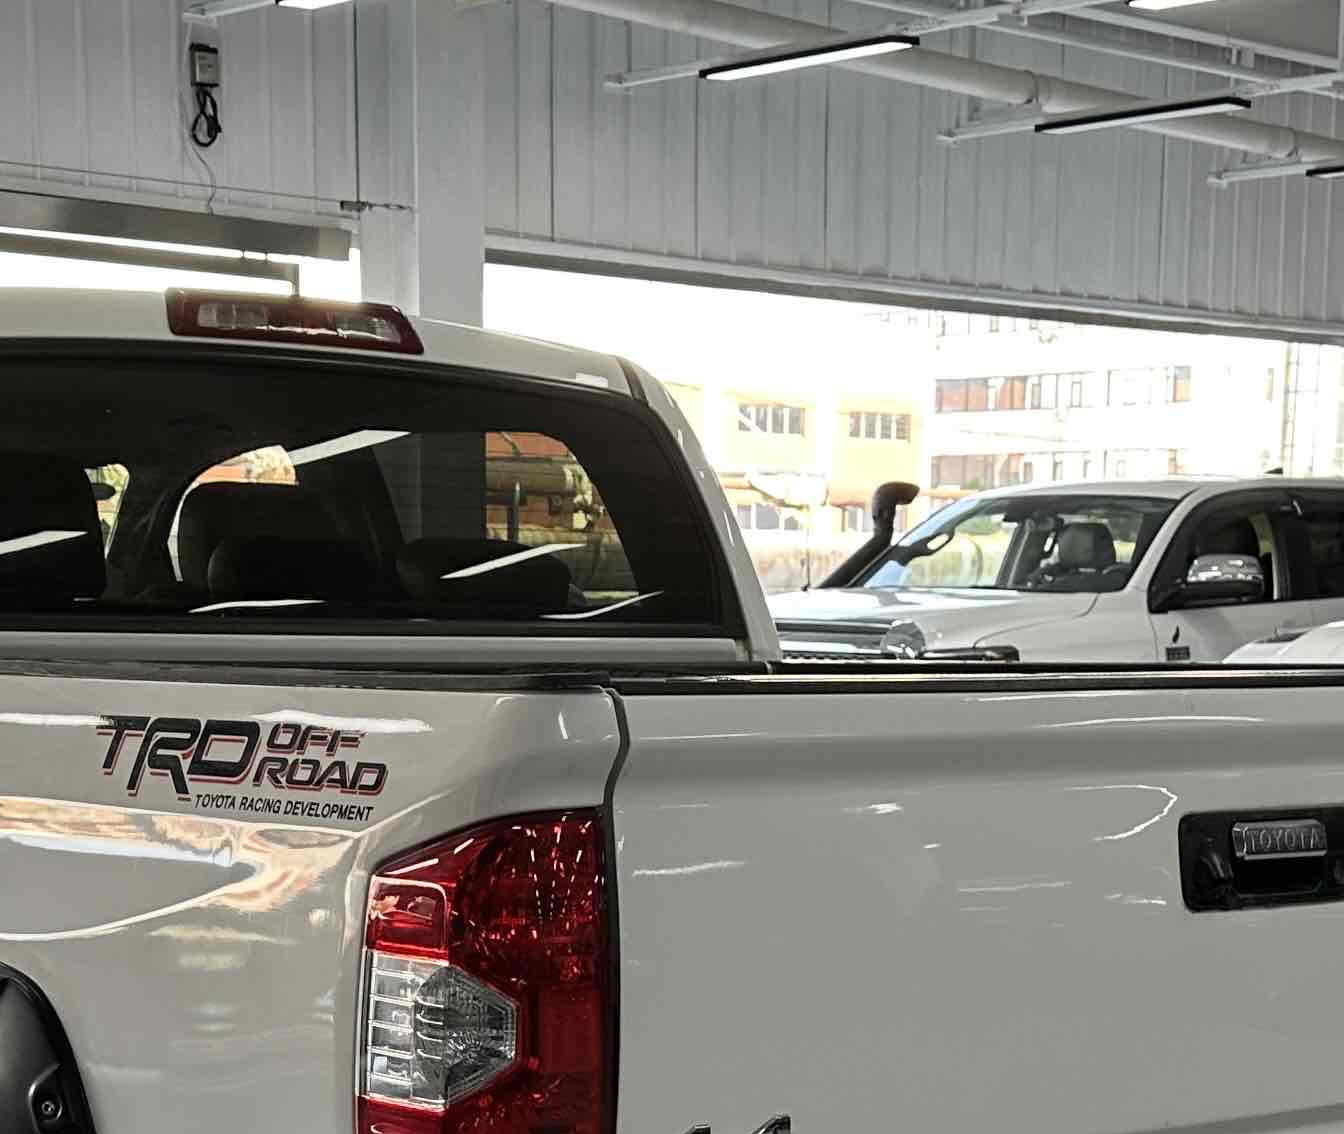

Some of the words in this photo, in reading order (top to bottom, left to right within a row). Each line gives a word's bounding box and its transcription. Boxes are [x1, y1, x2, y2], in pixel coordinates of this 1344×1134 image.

[96, 715, 261, 801] TRD
[266, 722, 367, 757] OFF
[253, 756, 388, 796] ROAD
[195, 794, 237, 810] TOYOTA
[239, 797, 281, 814] RACING
[284, 801, 375, 822] DEVELOPMENT
[1246, 827, 1321, 854] TOYOTA
